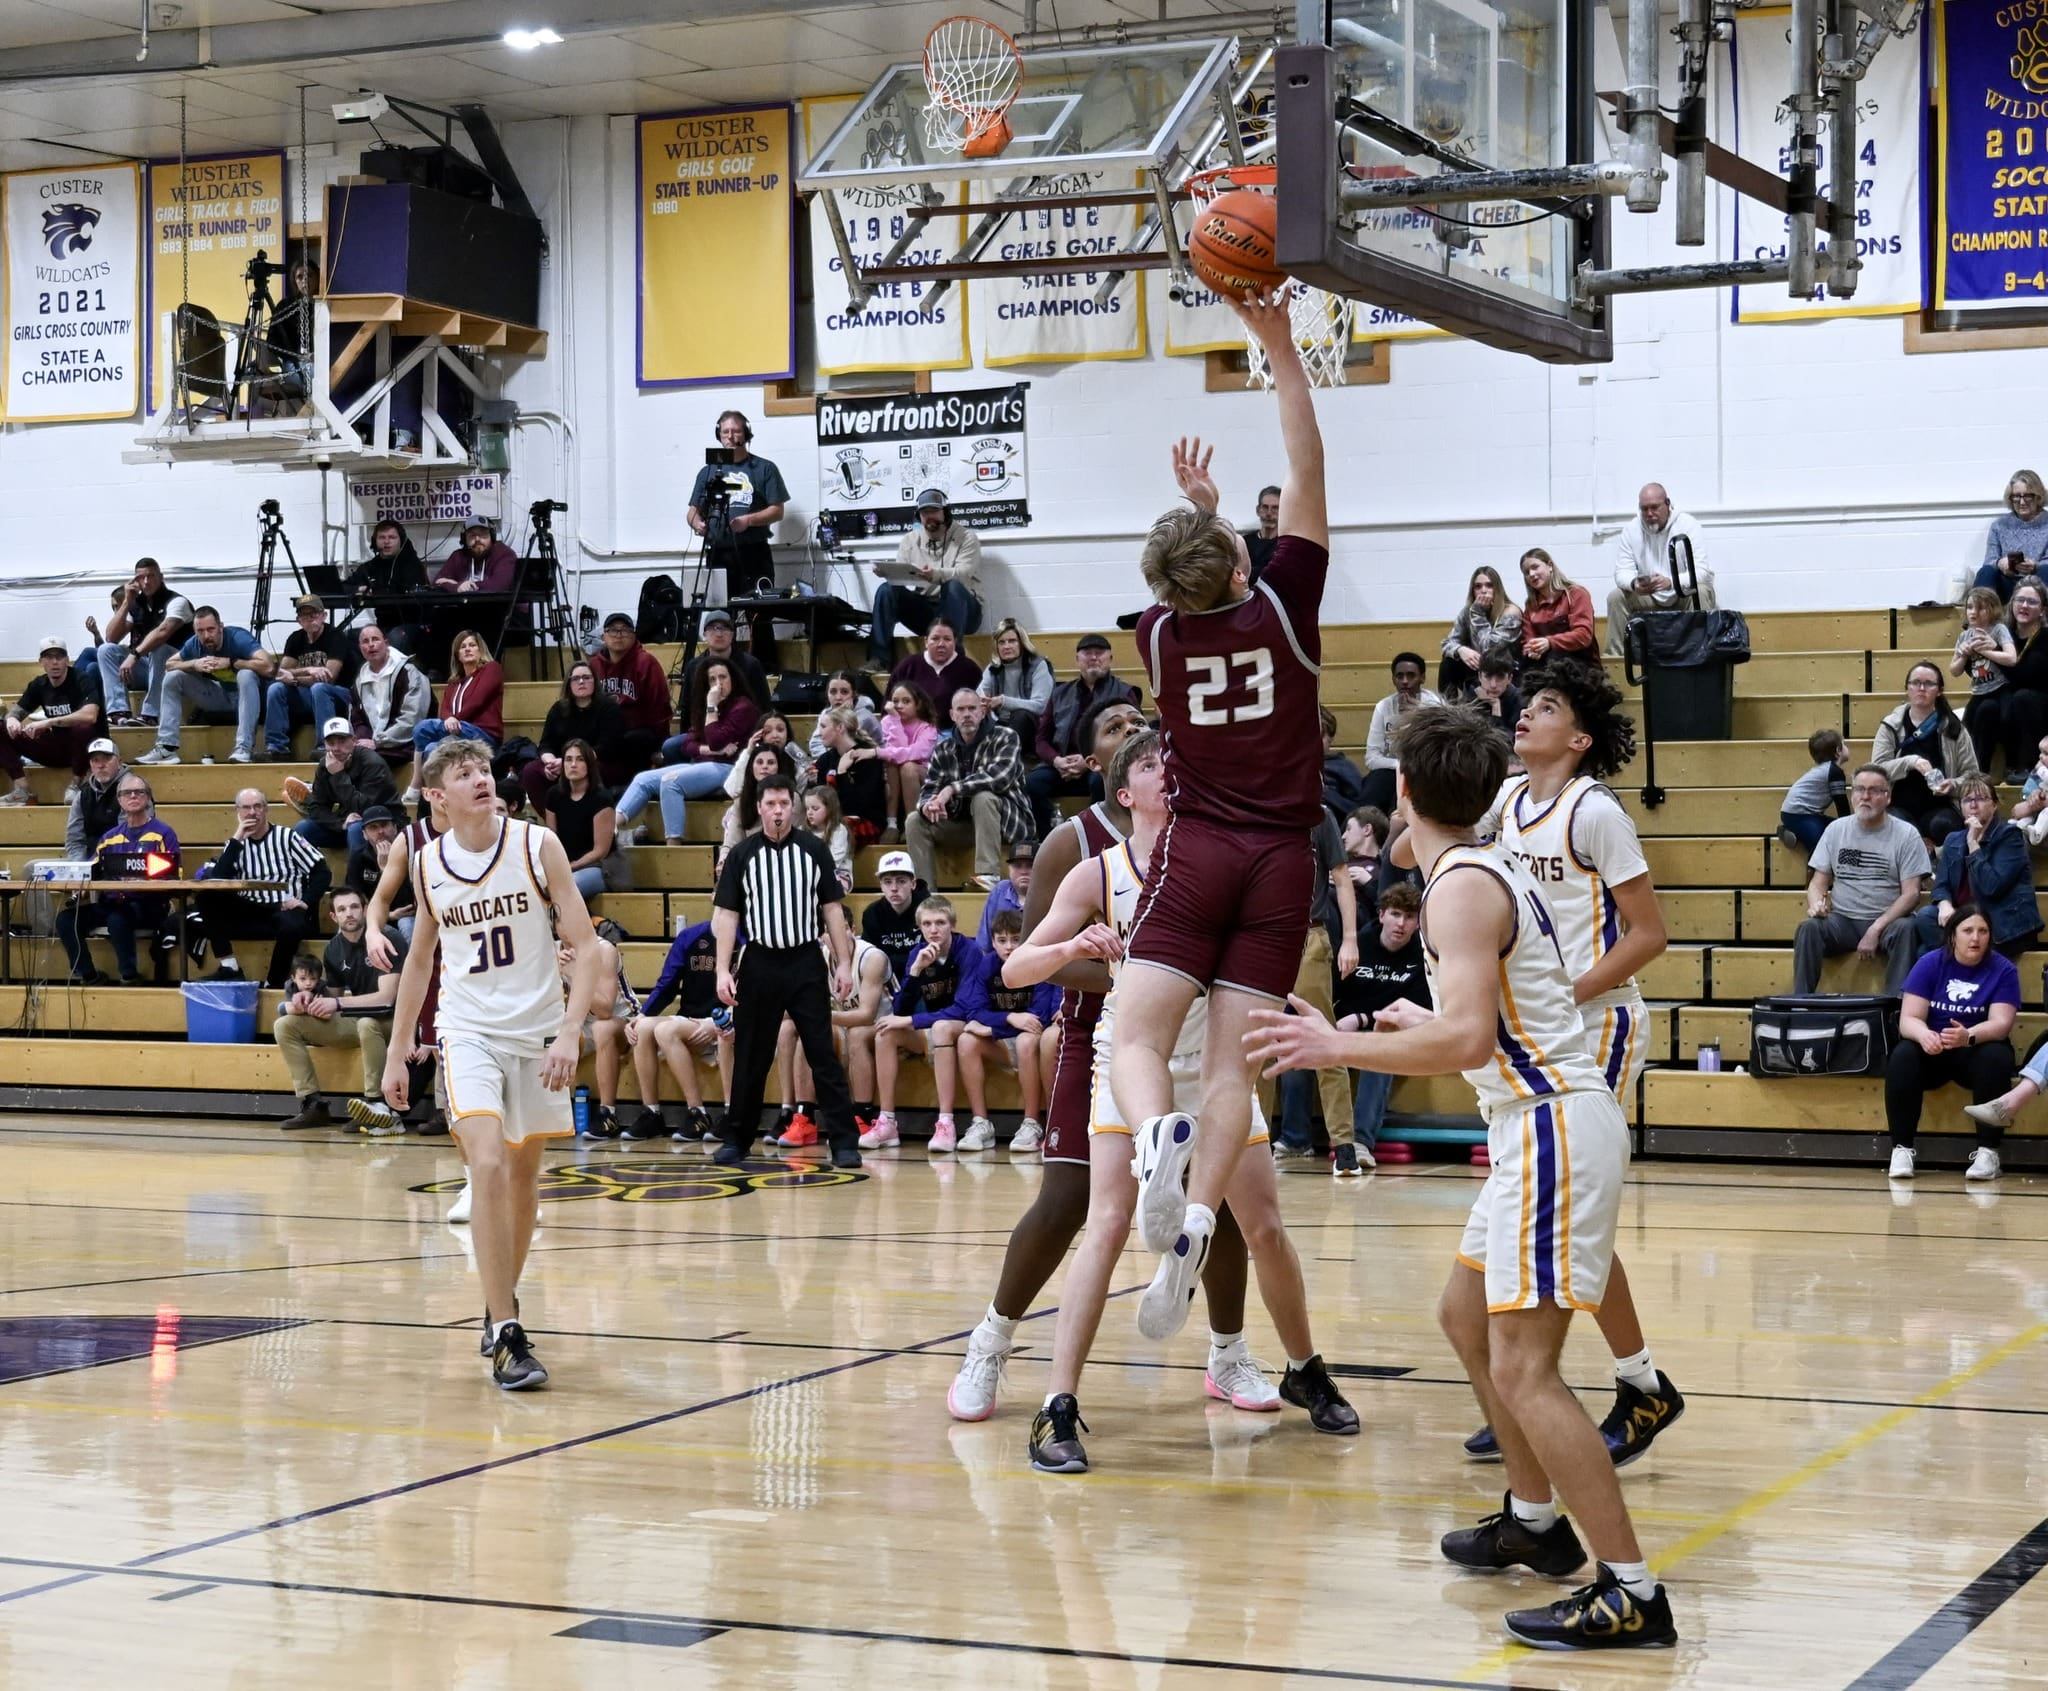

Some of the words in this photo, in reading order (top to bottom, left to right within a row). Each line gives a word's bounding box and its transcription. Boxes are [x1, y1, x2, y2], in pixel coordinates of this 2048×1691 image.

[676, 117, 755, 140] CUSTER
[664, 136, 769, 160] WILDCATS
[1986, 127, 2048, 158] 20
[183, 163, 251, 184] CUSTER
[677, 159, 715, 178] GIRLS
[720, 157, 755, 174] GOLF
[40, 179, 104, 199] CUSTER
[171, 180, 264, 203] WILDCATS
[656, 181, 690, 199] STATE
[697, 174, 778, 196] RUNNER-UP
[842, 183, 918, 209] WILDCAT
[192, 201, 230, 220] TRACK
[235, 200, 244, 216] &
[250, 198, 280, 215] FIELD
[1473, 204, 1521, 224] CHEER
[163, 223, 194, 240] STATE
[199, 216, 272, 237] RUNNER-UP
[1001, 240, 1057, 260] GIRLS
[1066, 236, 1117, 257] GOLF
[1952, 230, 2032, 252] CHAMPION
[35, 261, 111, 283] WILDCATS
[39, 289, 106, 315] 2021
[997, 296, 1121, 320] CHAMPIONS
[14, 322, 42, 341] GIRLS
[45, 322, 77, 339] CROSS
[80, 319, 132, 337] COUNTRY
[826, 308, 946, 330] CHAMPIONS
[41, 350, 89, 366] STATE
[94, 348, 105, 363] A
[22, 366, 123, 386] CHAMPIONS
[354, 482, 421, 497] RESERVED
[467, 478, 494, 491] FOR
[377, 495, 425, 508] CUSTER
[430, 493, 471, 506] VIDEO
[376, 506, 473, 522] PRODUCTIONS
[1185, 647, 1275, 726] 23
[442, 891, 529, 929] WILDCATS
[468, 925, 515, 975] 30
